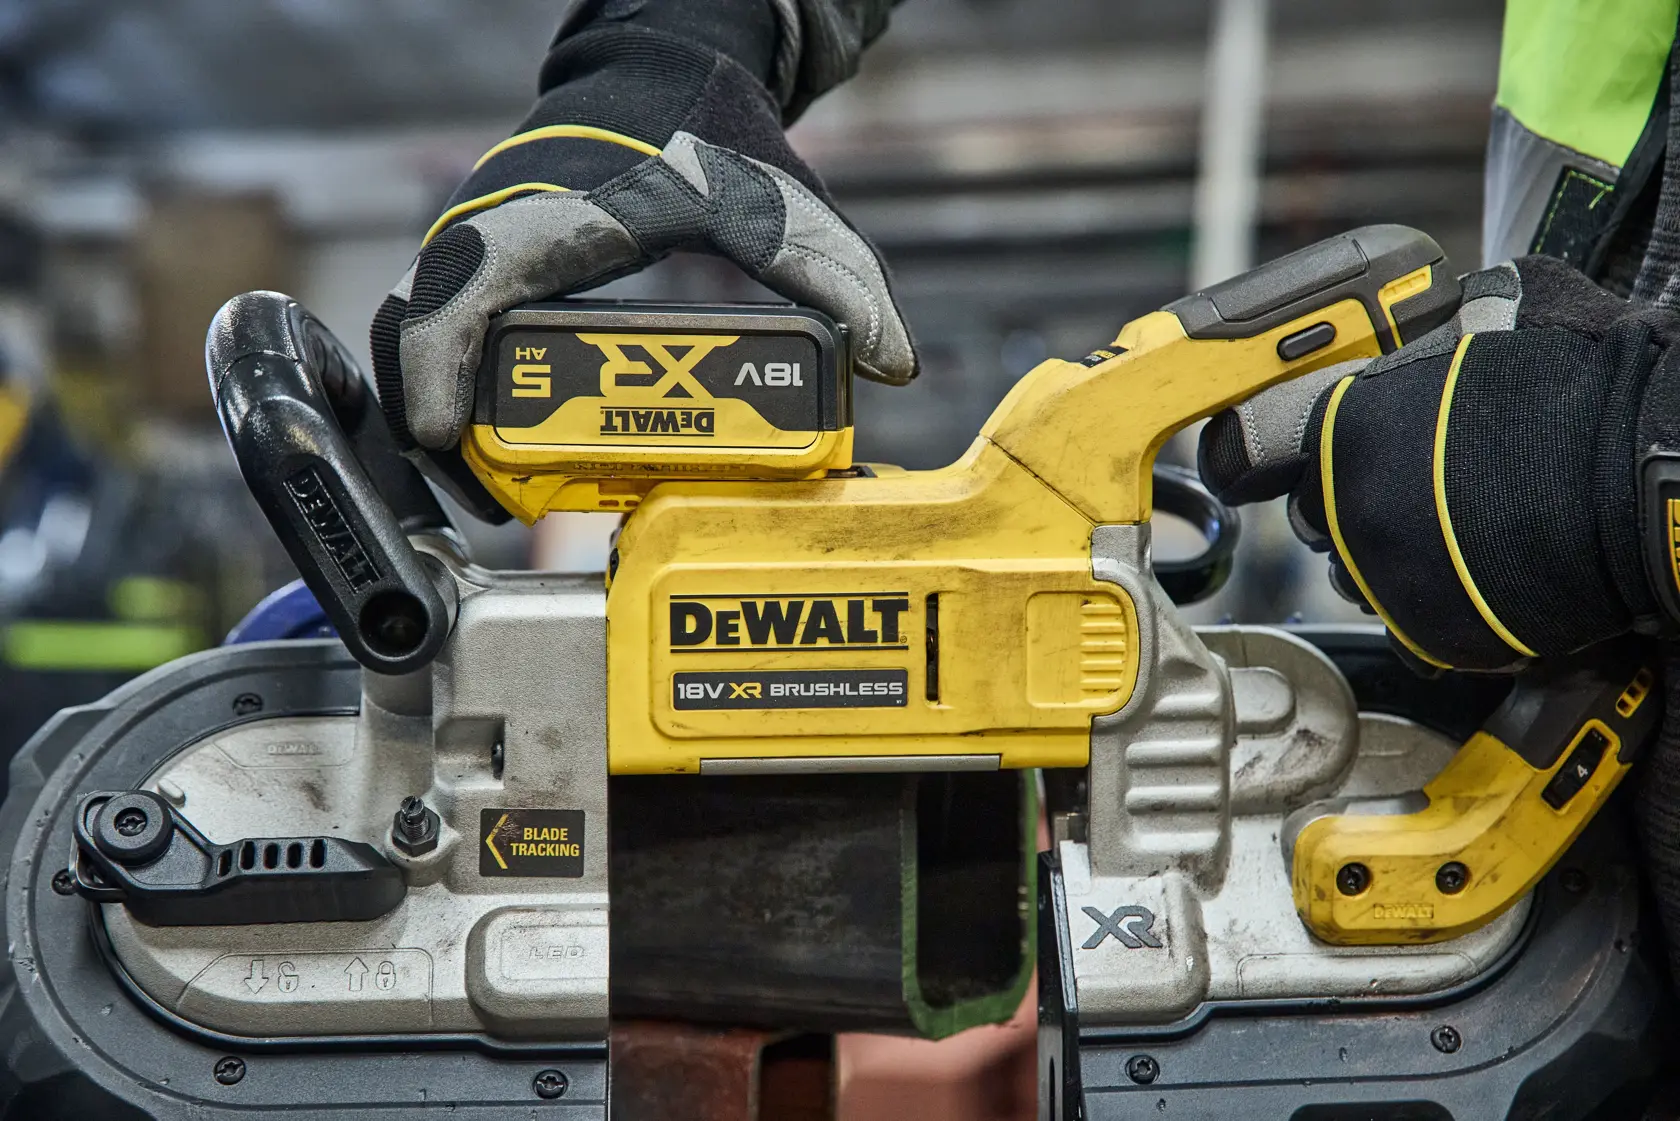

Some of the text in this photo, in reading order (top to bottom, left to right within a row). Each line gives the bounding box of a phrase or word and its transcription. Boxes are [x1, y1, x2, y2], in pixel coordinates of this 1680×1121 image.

[515, 347, 547, 360] AH
[590, 334, 728, 398] XR
[511, 364, 551, 397] 5
[733, 363, 803, 387] 18V
[678, 682, 903, 699] 18V XR BRUSHLESS
[1577, 764, 1589, 778] 4
[523, 827, 568, 841] BLADE
[510, 843, 580, 857] TRACKING
[1080, 905, 1164, 950] XR
[528, 945, 587, 960] LED
